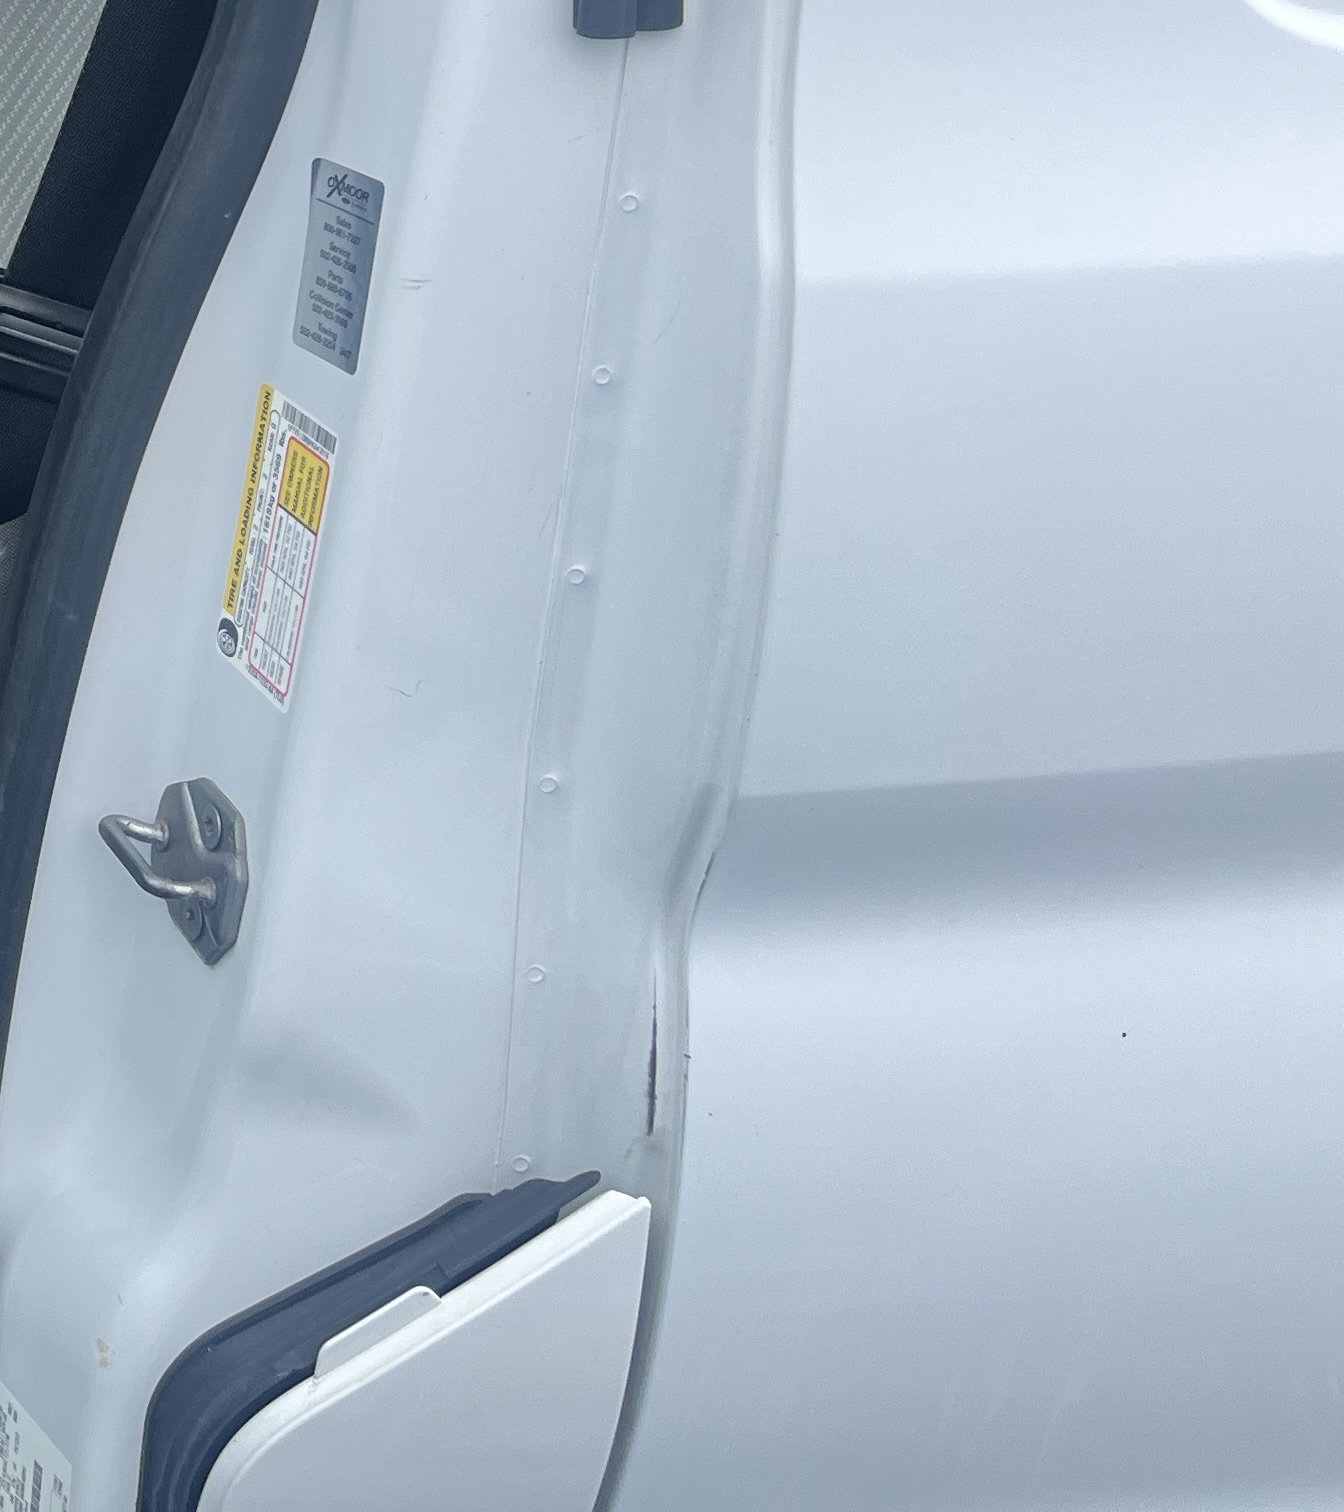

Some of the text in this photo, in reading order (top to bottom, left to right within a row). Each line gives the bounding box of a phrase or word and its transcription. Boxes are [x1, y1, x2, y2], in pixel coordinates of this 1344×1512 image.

[226, 390, 271, 609] TIRE AND LOADING INFORMATION
